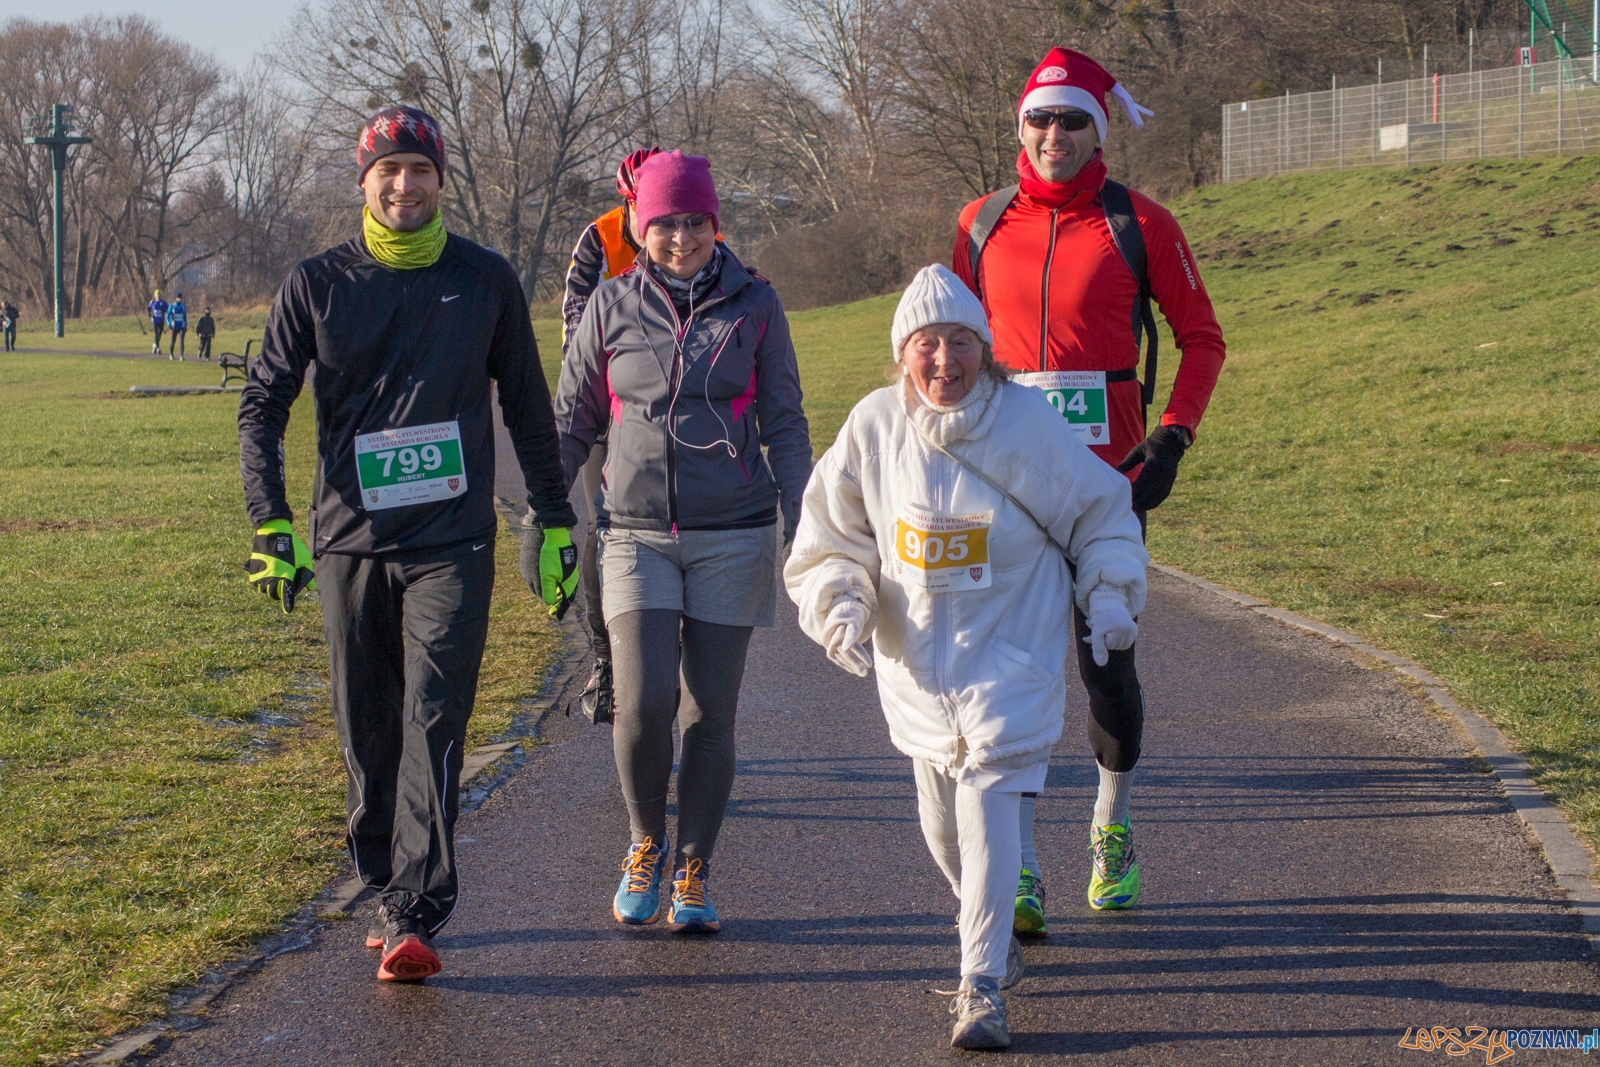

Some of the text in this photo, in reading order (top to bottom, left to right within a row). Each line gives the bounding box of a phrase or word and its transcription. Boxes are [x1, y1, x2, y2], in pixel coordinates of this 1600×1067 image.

[1522, 50, 1530, 65] H
[1174, 241, 1197, 290] SALOMON
[1046, 390, 1088, 416] 04
[367, 426, 451, 444] XXXII BIEG SYLWESTROWY
[381, 439, 415, 449] RYSZARDA
[416, 433, 449, 443] BURGIELA
[376, 444, 443, 478] 799
[397, 473, 426, 482] HUBERT
[911, 520, 945, 531] RYSZARDA
[946, 521, 981, 530] BURGIELA
[915, 513, 930, 522] BIEG
[931, 514, 986, 524] SYLWESTROWY
[904, 530, 969, 564] 905
